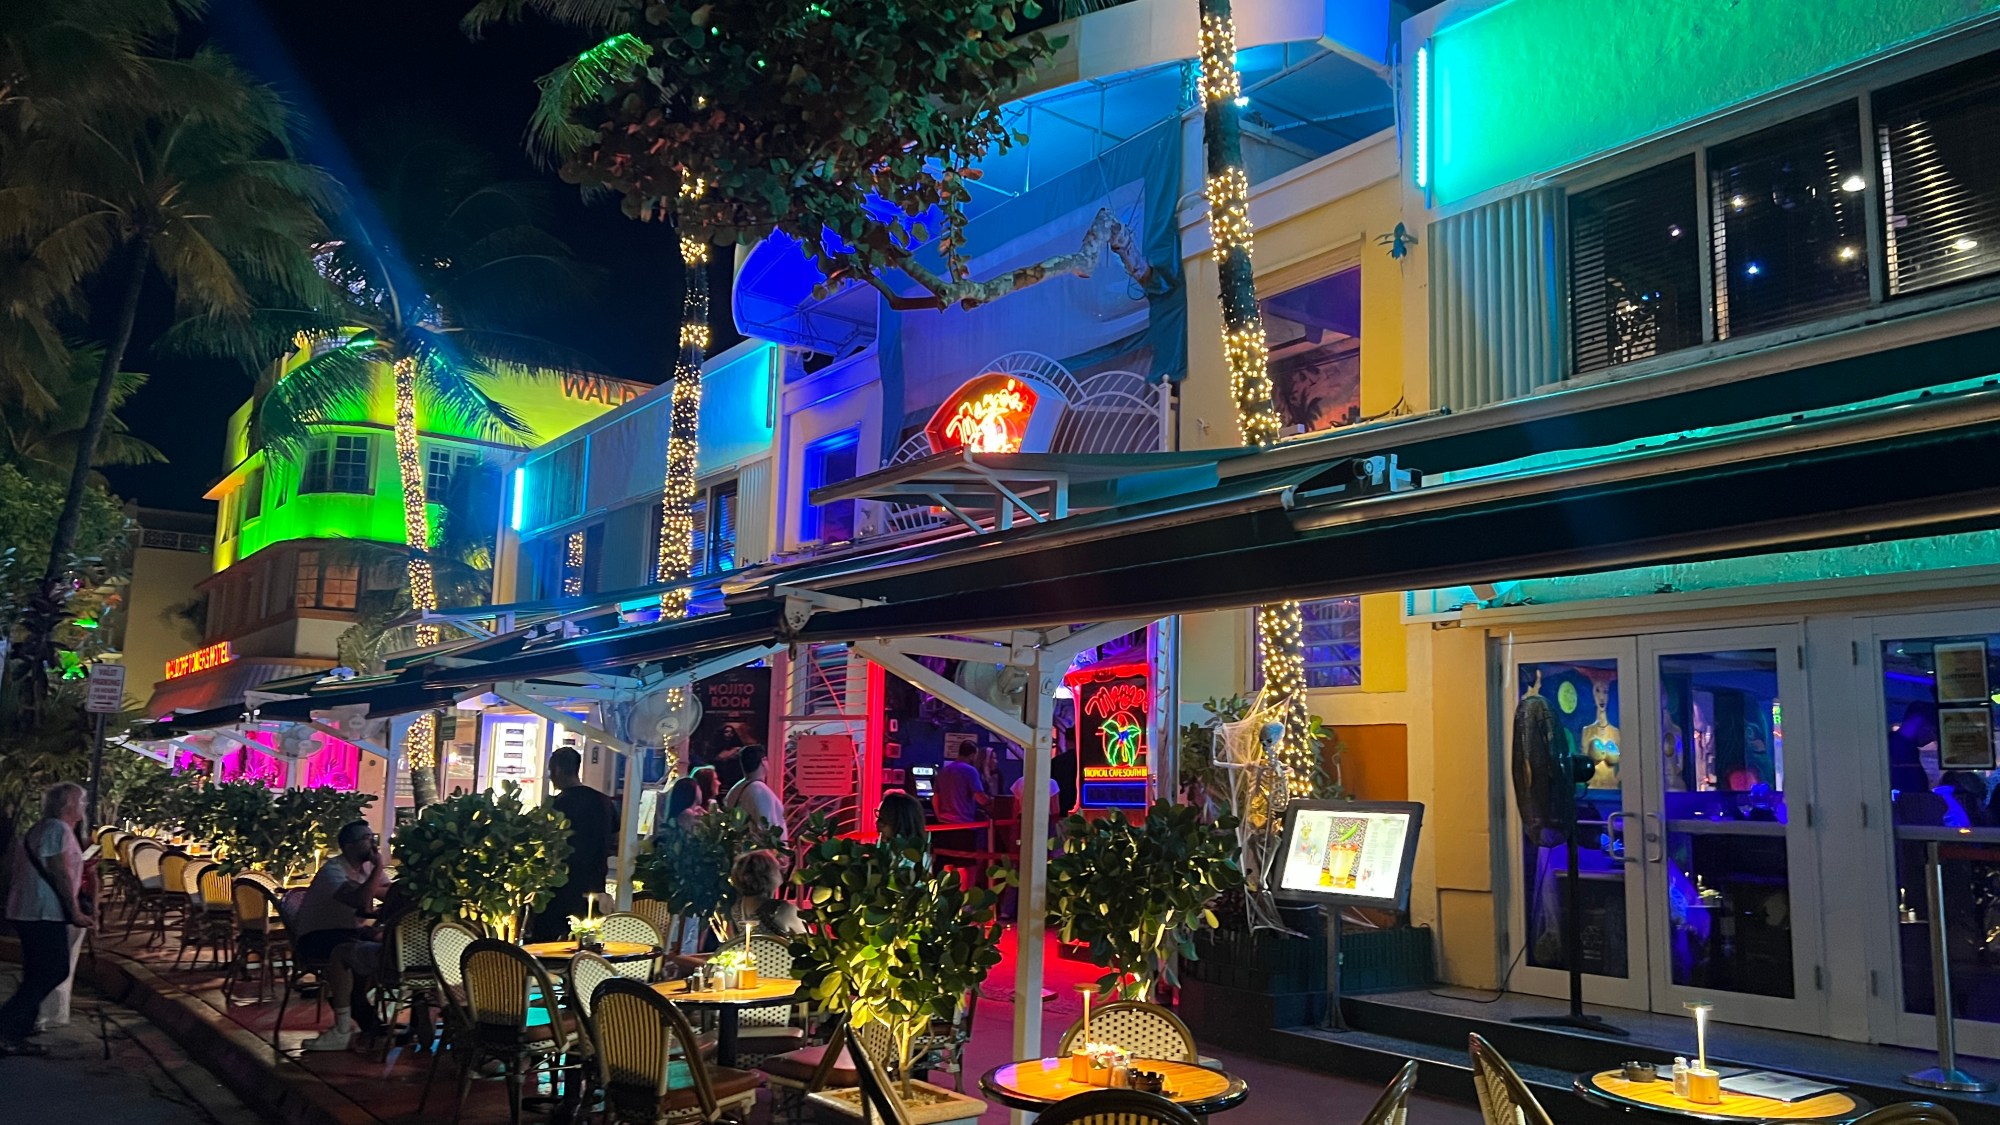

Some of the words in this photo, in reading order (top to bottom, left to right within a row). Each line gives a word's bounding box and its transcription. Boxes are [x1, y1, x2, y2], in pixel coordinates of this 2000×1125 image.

[560, 371, 640, 406] WALD
[708, 683, 754, 695] MOJITO
[711, 696, 751, 708] ROOM
[1084, 685, 1148, 719] Mango
[1084, 767, 1108, 778] TROPICAL
[1108, 768, 1124, 778] CAFE
[1123, 767, 1142, 777] SOUTH
